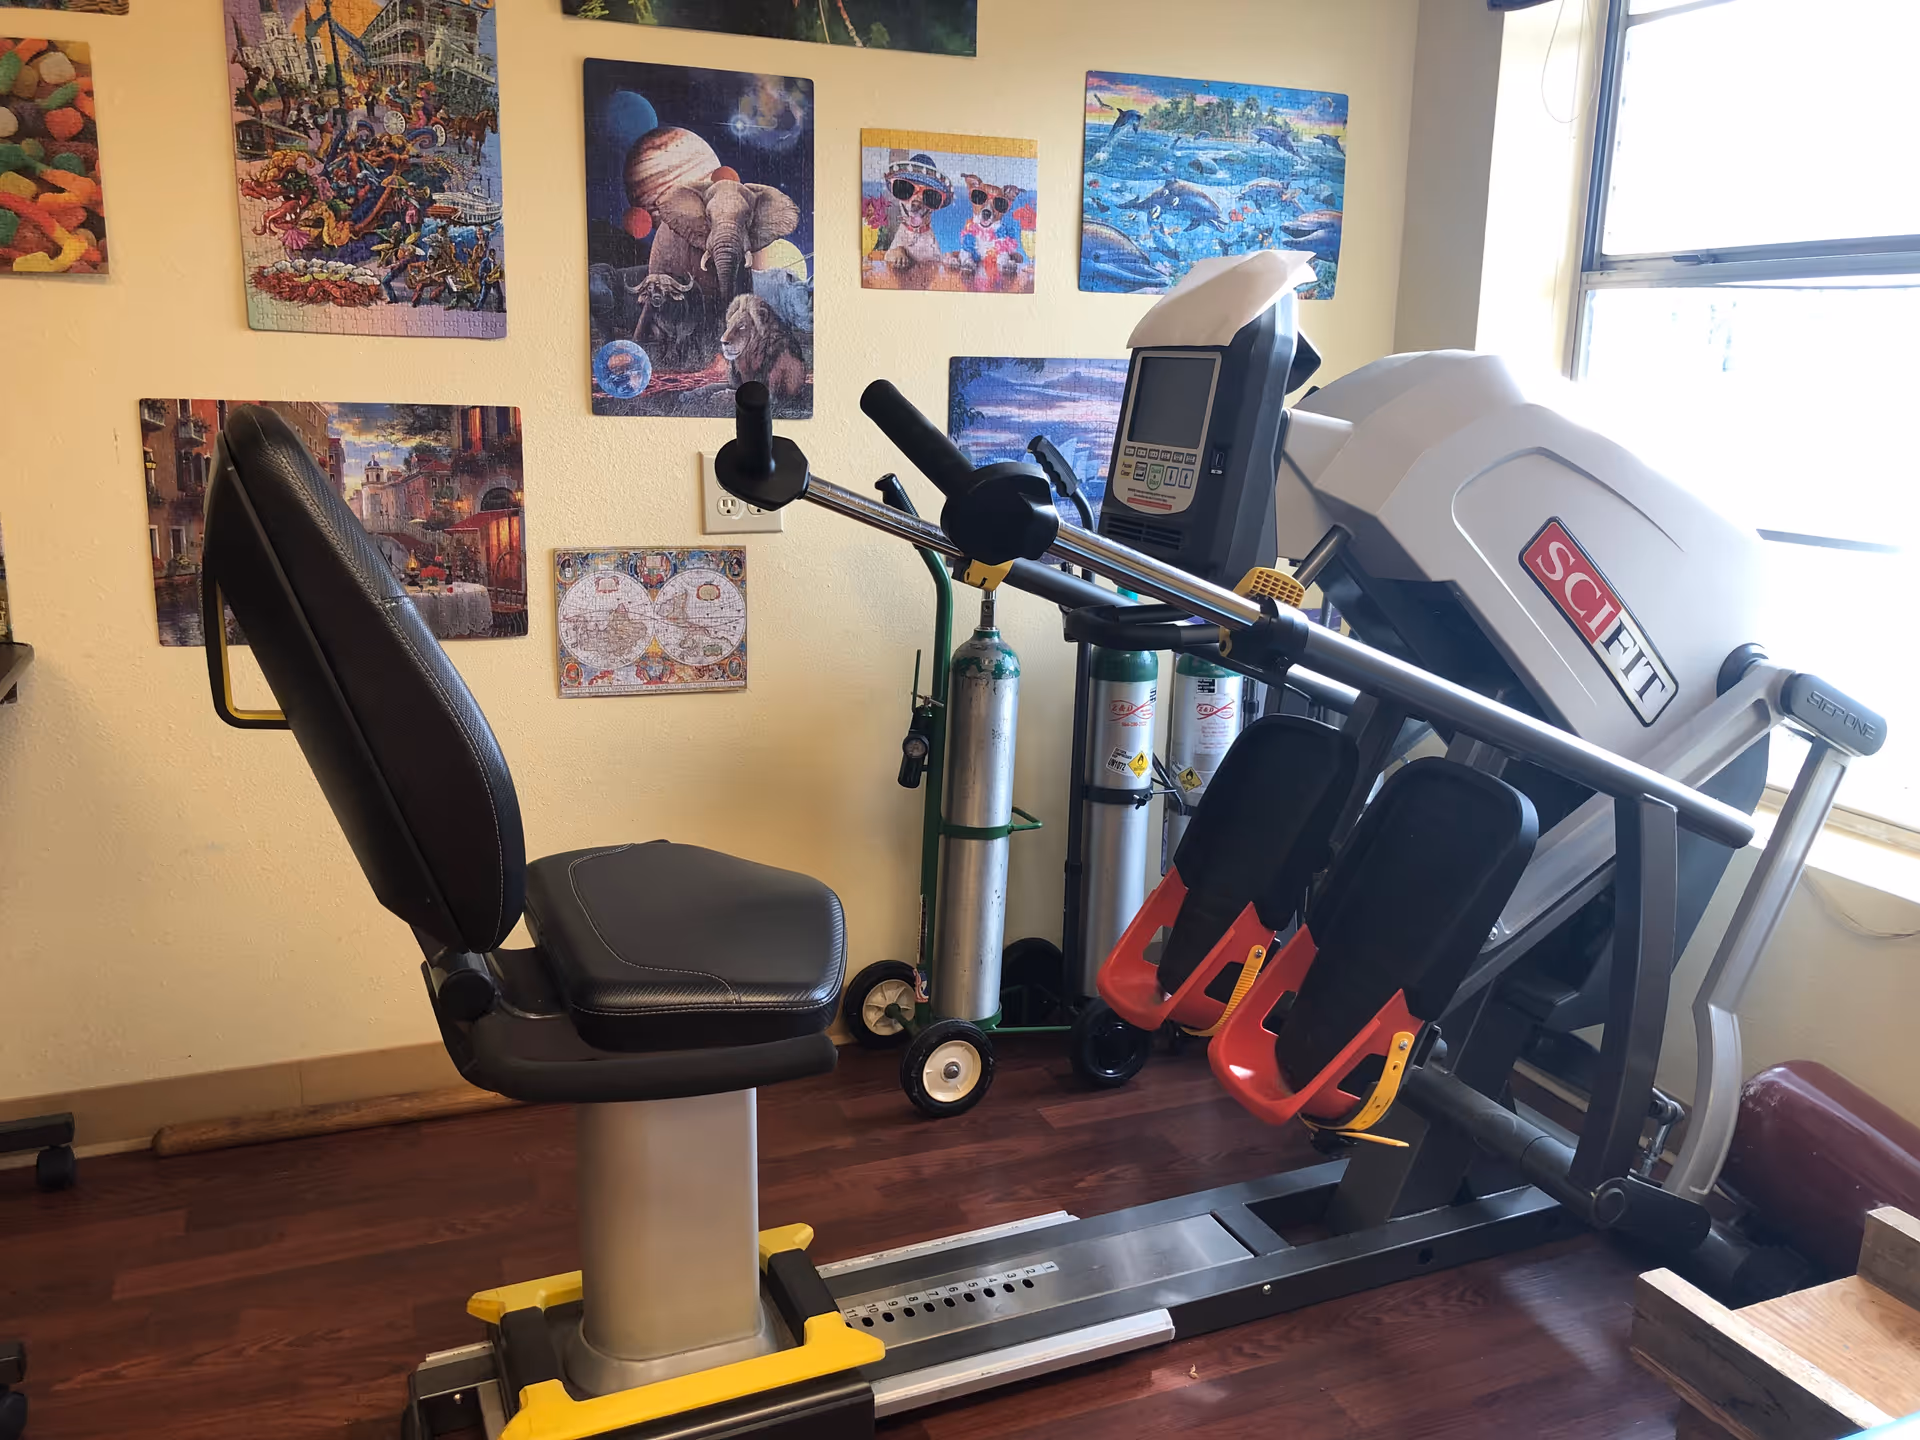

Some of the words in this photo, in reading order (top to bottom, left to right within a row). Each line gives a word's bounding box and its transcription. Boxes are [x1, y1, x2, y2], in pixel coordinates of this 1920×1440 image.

[1536, 541, 1666, 703] SCIFIT
[1807, 690, 1846, 717] STEP
[1844, 712, 1877, 740] ONE
[846, 1309, 858, 1318] 11
[866, 1303, 879, 1313] 10
